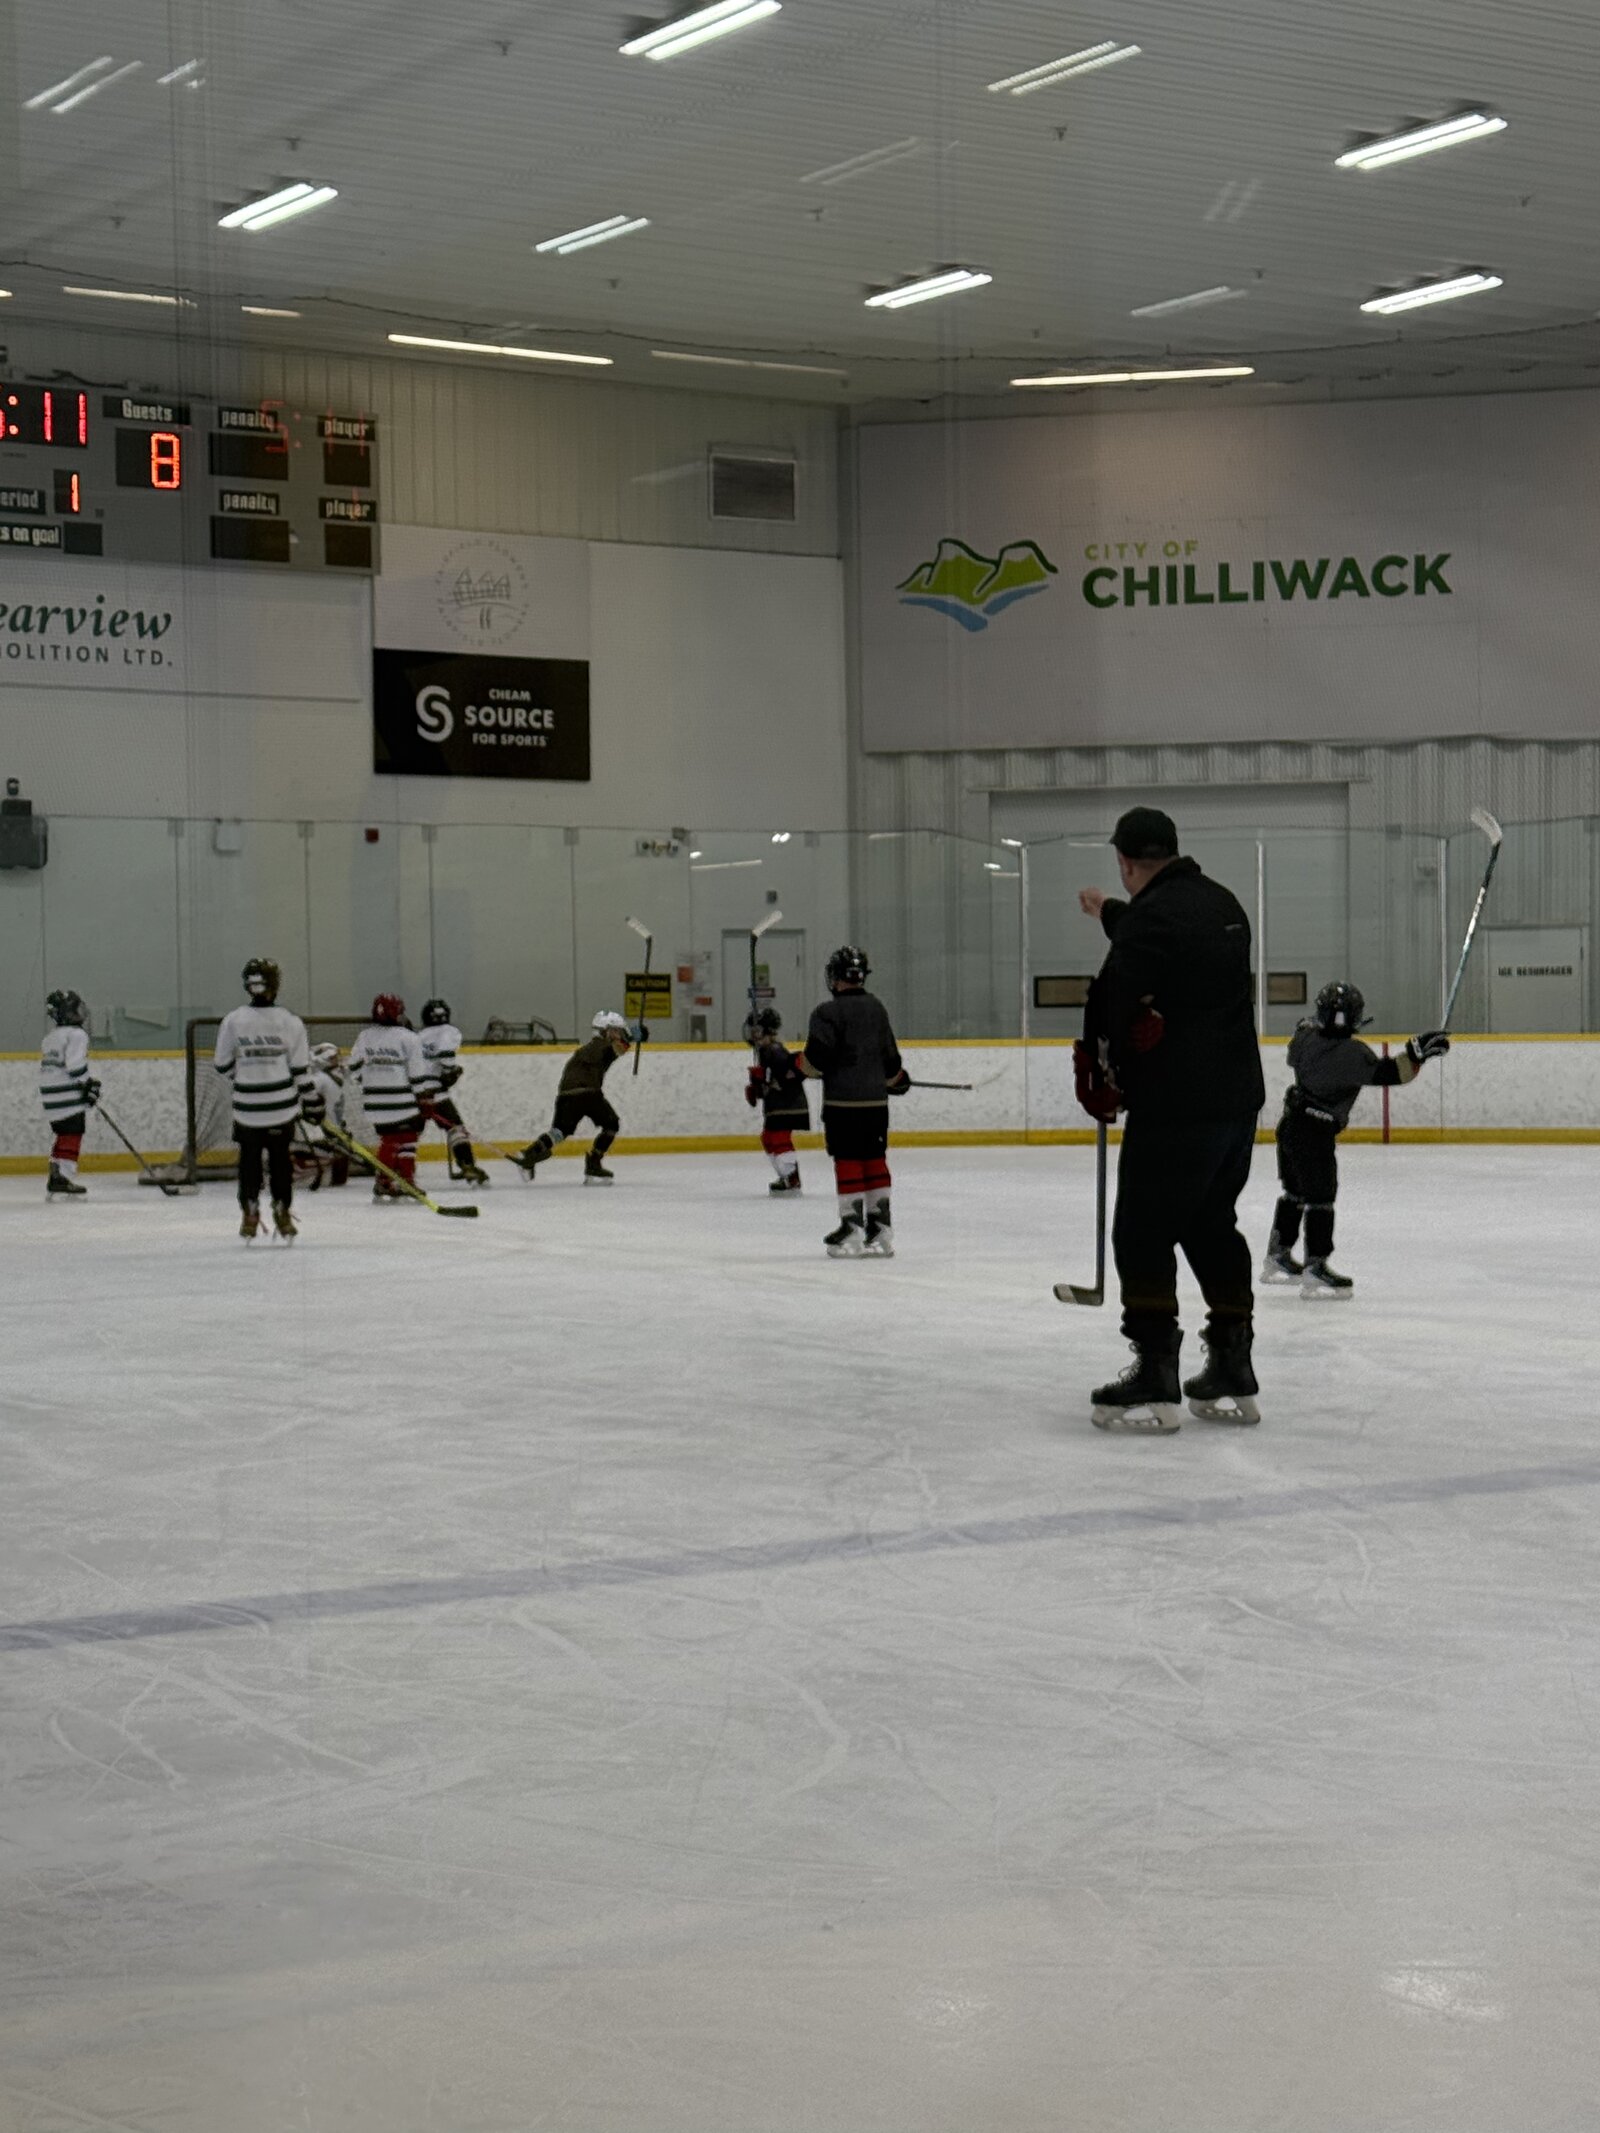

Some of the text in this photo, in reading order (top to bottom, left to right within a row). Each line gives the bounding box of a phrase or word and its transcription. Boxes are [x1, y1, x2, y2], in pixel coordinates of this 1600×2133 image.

[0, 391, 87, 445] :11
[122, 399, 173, 421] Guests
[221, 411, 276, 432] penalty
[324, 419, 369, 439] player
[151, 433, 180, 488] 8
[0, 489, 39, 508] eriod
[71, 474, 80, 513] 1
[223, 493, 277, 514] penalty
[326, 501, 370, 520] player
[12, 527, 29, 542] on
[32, 527, 60, 546] goal
[1085, 539, 1199, 560] CITY OF
[1082, 553, 1453, 609] CHILLIWACK
[0, 643, 173, 667] OLITION LTD.
[489, 688, 531, 701] CHEAM
[464, 705, 555, 729] SOURCE
[472, 732, 547, 747] FOR SPORTS
